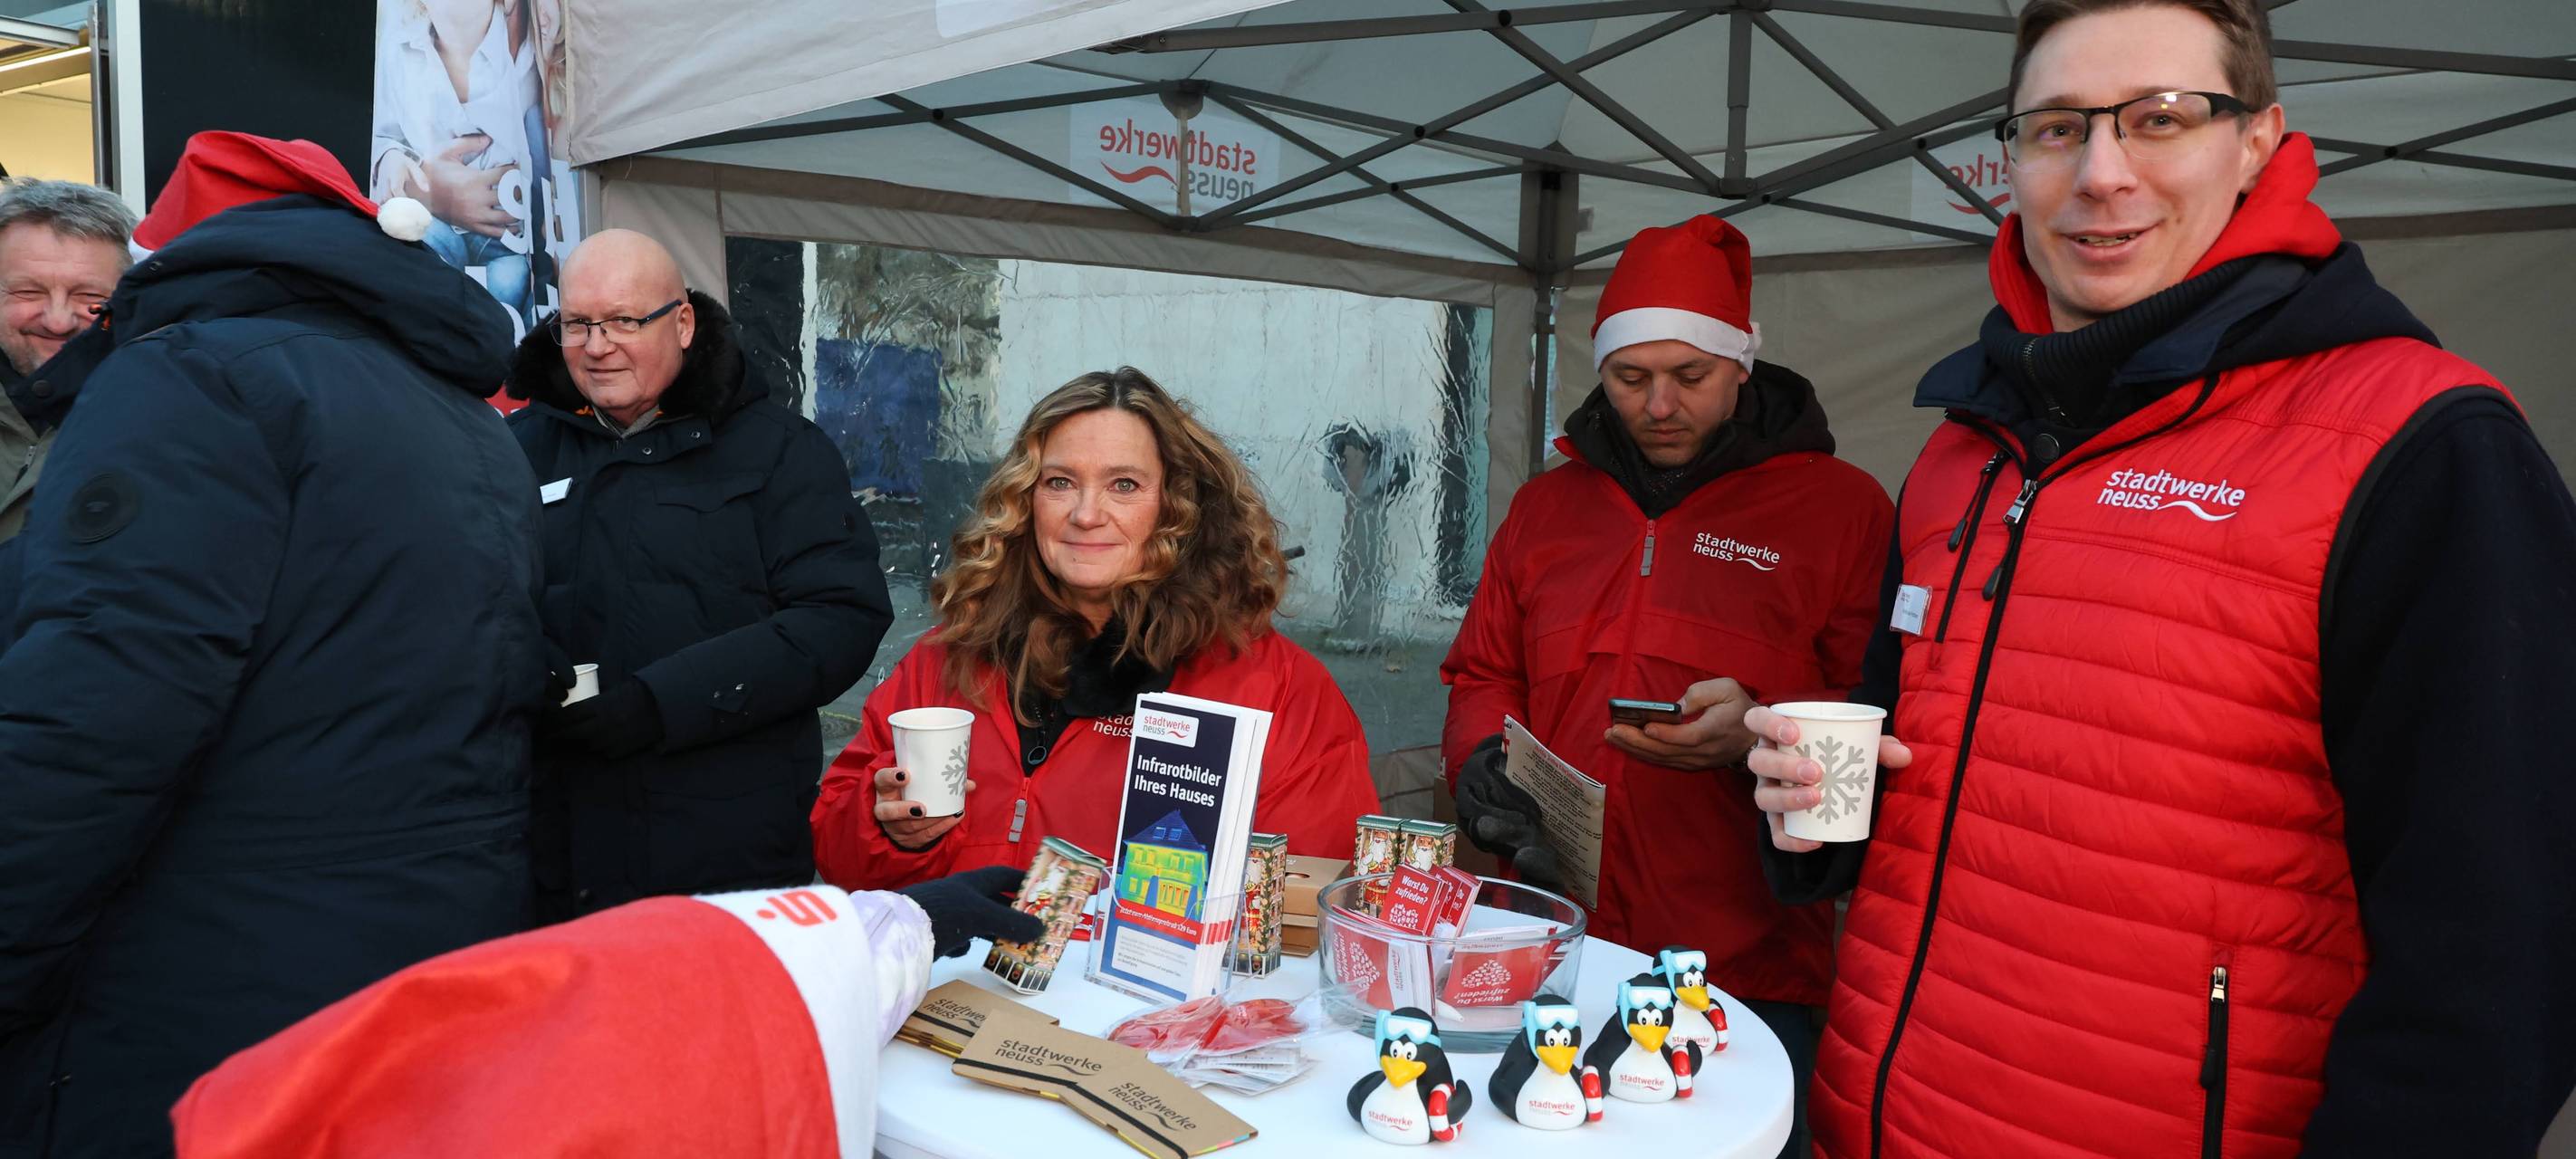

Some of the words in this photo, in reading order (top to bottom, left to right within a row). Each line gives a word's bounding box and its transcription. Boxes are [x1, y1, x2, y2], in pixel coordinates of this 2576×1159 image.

[2106, 468, 2246, 506] stadtwerke
[2097, 487, 2162, 511] neuss
[1693, 543, 1734, 561] neuss
[1696, 532, 1780, 563] stadtwerke
[1143, 724, 1166, 736] neuss
[1144, 714, 1191, 733] stadtwerke
[1137, 755, 1221, 787] Infrarotbilder
[1135, 775, 1166, 796] Ihres
[1170, 783, 1215, 807] Hauses
[1395, 887, 1428, 905] zufrieden?
[924, 1003, 960, 1020] neuss
[995, 1047, 1043, 1067] neuss
[1001, 1039, 1103, 1072] stadtwerke
[1619, 1074, 1664, 1087] stadtwerke
[1108, 1086, 1148, 1112] neuss
[1121, 1081, 1197, 1130] stadtwerke
[1528, 1099, 1575, 1111] stadtwerke
[1368, 1110, 1412, 1126] stadtwerke
